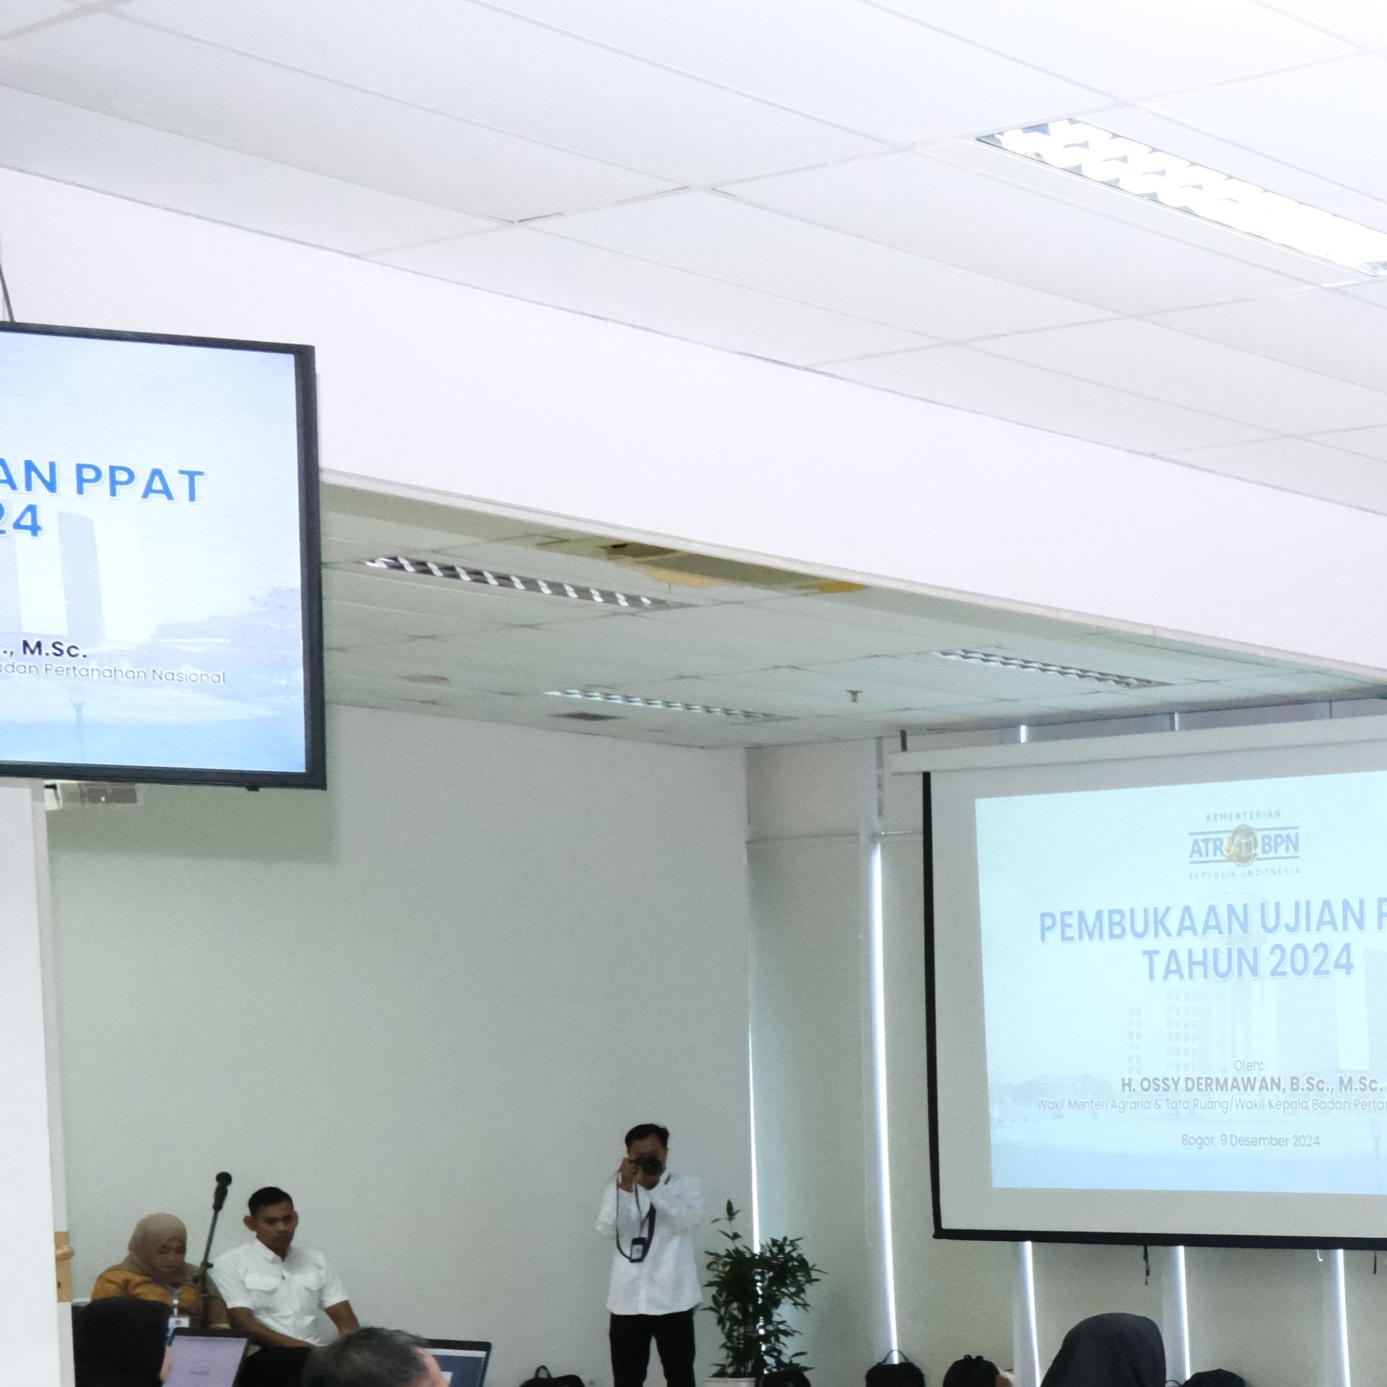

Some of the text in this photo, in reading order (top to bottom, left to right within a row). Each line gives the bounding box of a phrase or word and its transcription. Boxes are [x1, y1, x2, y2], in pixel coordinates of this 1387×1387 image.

[76, 463, 206, 503] PPAT
[22, 639, 87, 658] M.Sc.
[44, 663, 147, 681] Pertanahan
[152, 668, 226, 684] Nasional
[1189, 832, 1300, 858] ATR BPN
[1040, 902, 1249, 943] PEMBUKAAN
[1260, 898, 1365, 933] UJIAN
[1142, 942, 1354, 981] TAHUN 2024
[1234, 1060, 1264, 1073] Oleh:
[1121, 1076, 1383, 1094] H. OSSY DERMAWAN, B.Sc., M.Sc.
[1111, 1099, 1151, 1114] Agraria
[1166, 1099, 1190, 1110] Tata
[1268, 1099, 1308, 1113] Kepala
[1312, 1099, 1349, 1111] Badan
[1220, 1134, 1227, 1146] 9
[1230, 1134, 1289, 1147] Desember
[1293, 1134, 1320, 1147] 2024
